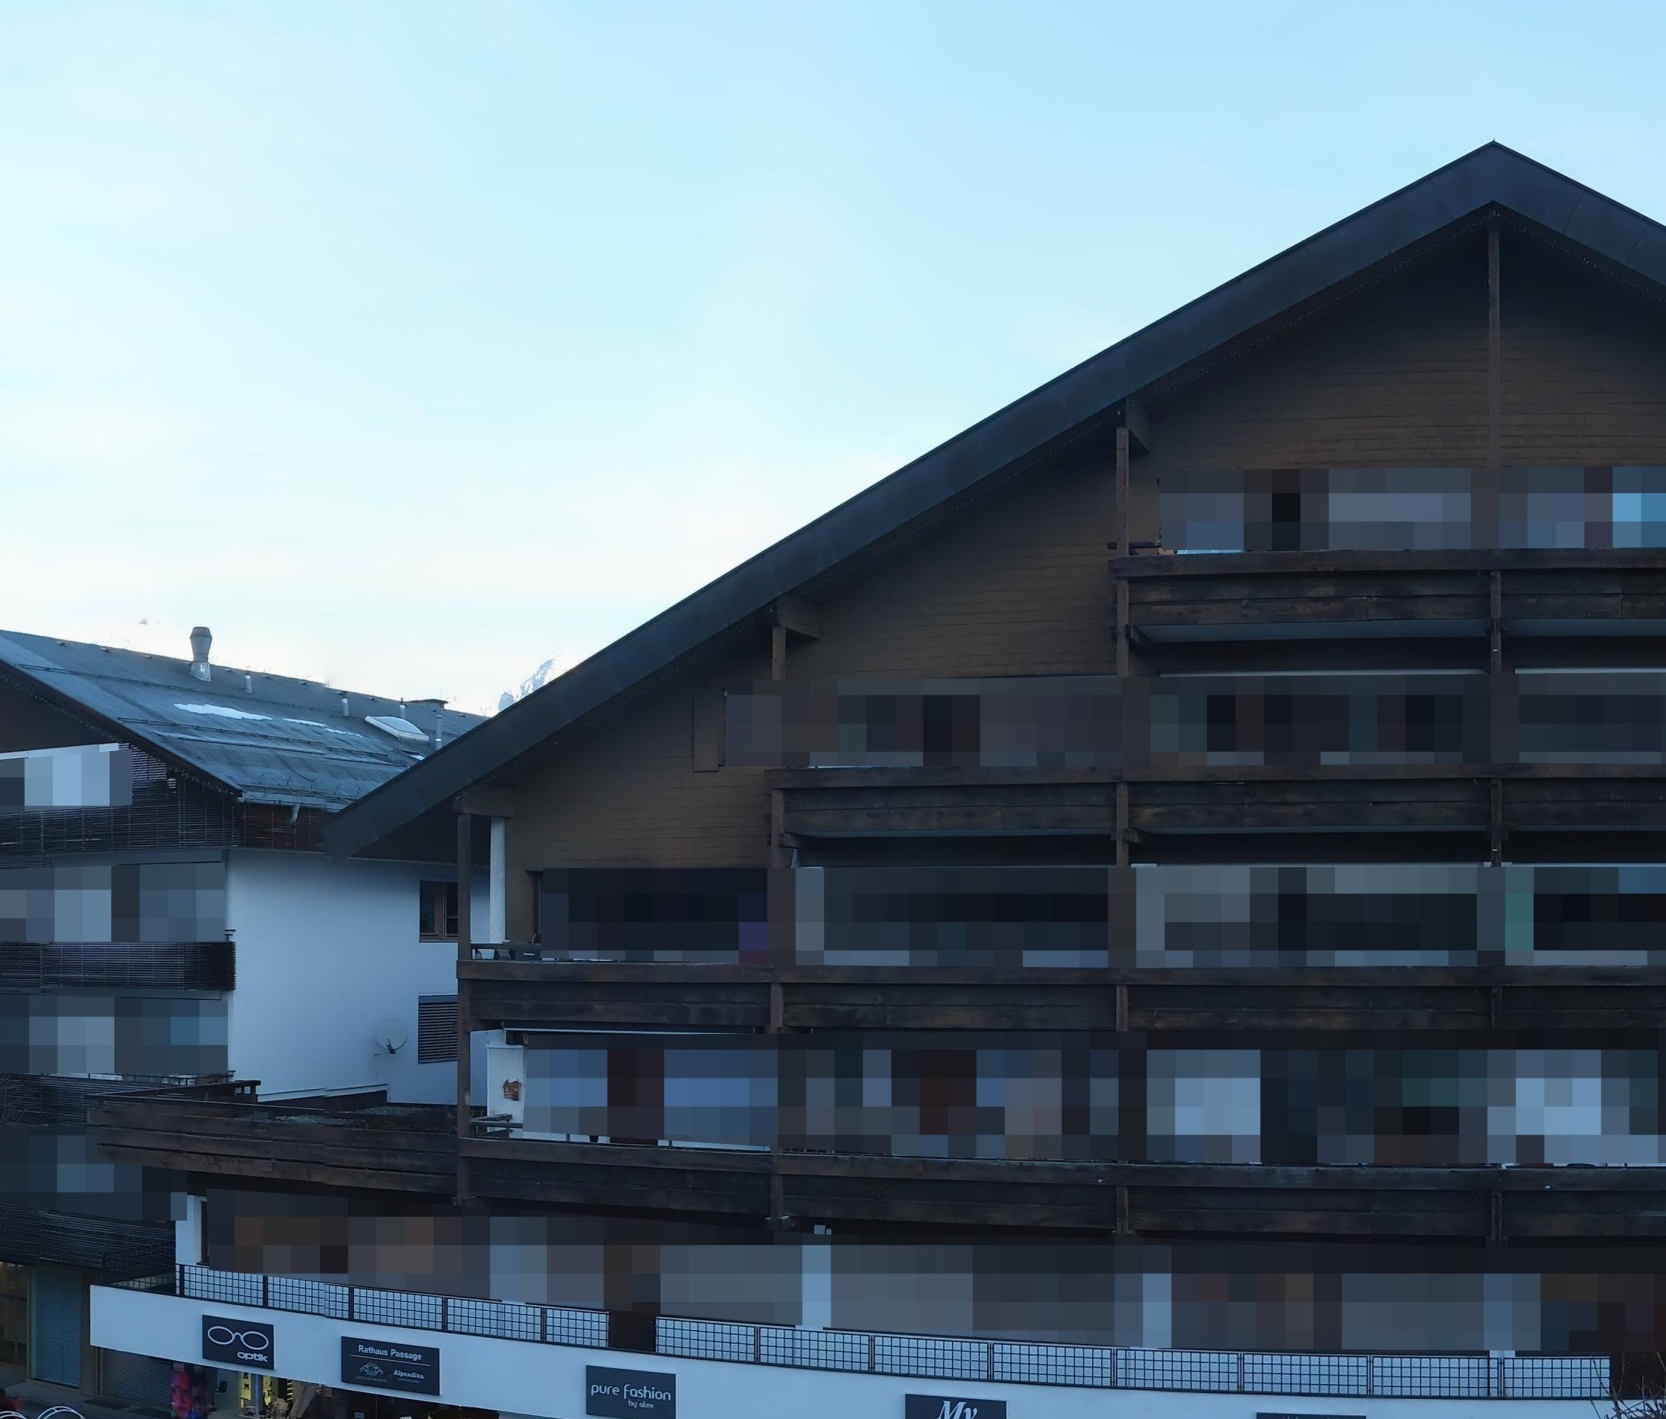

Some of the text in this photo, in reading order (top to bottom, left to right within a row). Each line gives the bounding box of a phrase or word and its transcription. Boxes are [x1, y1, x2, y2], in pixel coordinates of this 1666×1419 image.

[237, 1351, 269, 1364] optik
[358, 1344, 423, 1362] Rathaus Passage
[590, 1383, 672, 1401] pure fashion
[628, 1399, 638, 1409] by
